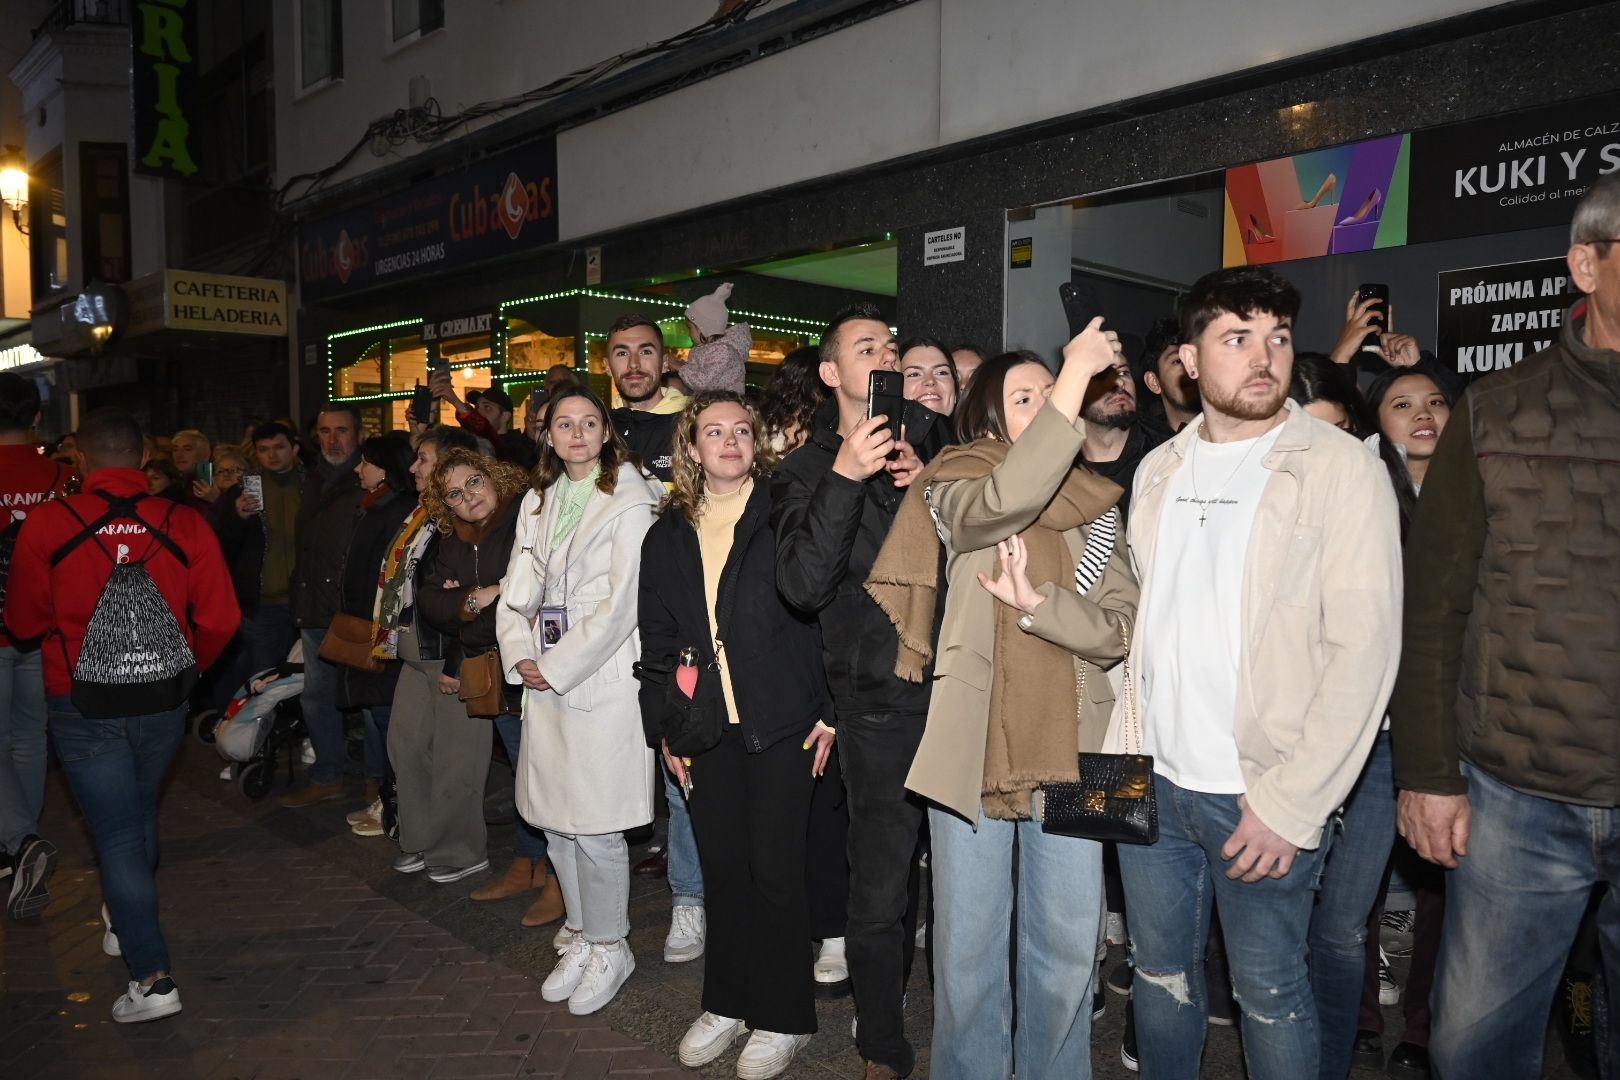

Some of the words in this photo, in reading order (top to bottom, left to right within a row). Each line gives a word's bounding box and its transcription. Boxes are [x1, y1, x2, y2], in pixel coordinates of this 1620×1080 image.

[137, 0, 199, 177] RIA
[1498, 131, 1561, 153] ALMACÉN
[1563, 129, 1582, 141] DE
[1454, 155, 1547, 198] KUKI
[1559, 148, 1588, 181] Y
[1499, 190, 1547, 208] Calidad
[1548, 189, 1561, 200] al
[1564, 184, 1590, 199] mej
[927, 234, 953, 244] CARTELES
[953, 232, 962, 240] NO
[374, 252, 411, 276] URGENCIAS
[411, 248, 420, 266] 24
[420, 242, 446, 264] HORAS
[173, 280, 281, 303] CAFETERIA
[1449, 280, 1536, 306] PRÓXIMA
[173, 304, 282, 326] HELADERIA
[422, 323, 438, 341] EL
[1456, 342, 1524, 374] KUKI
